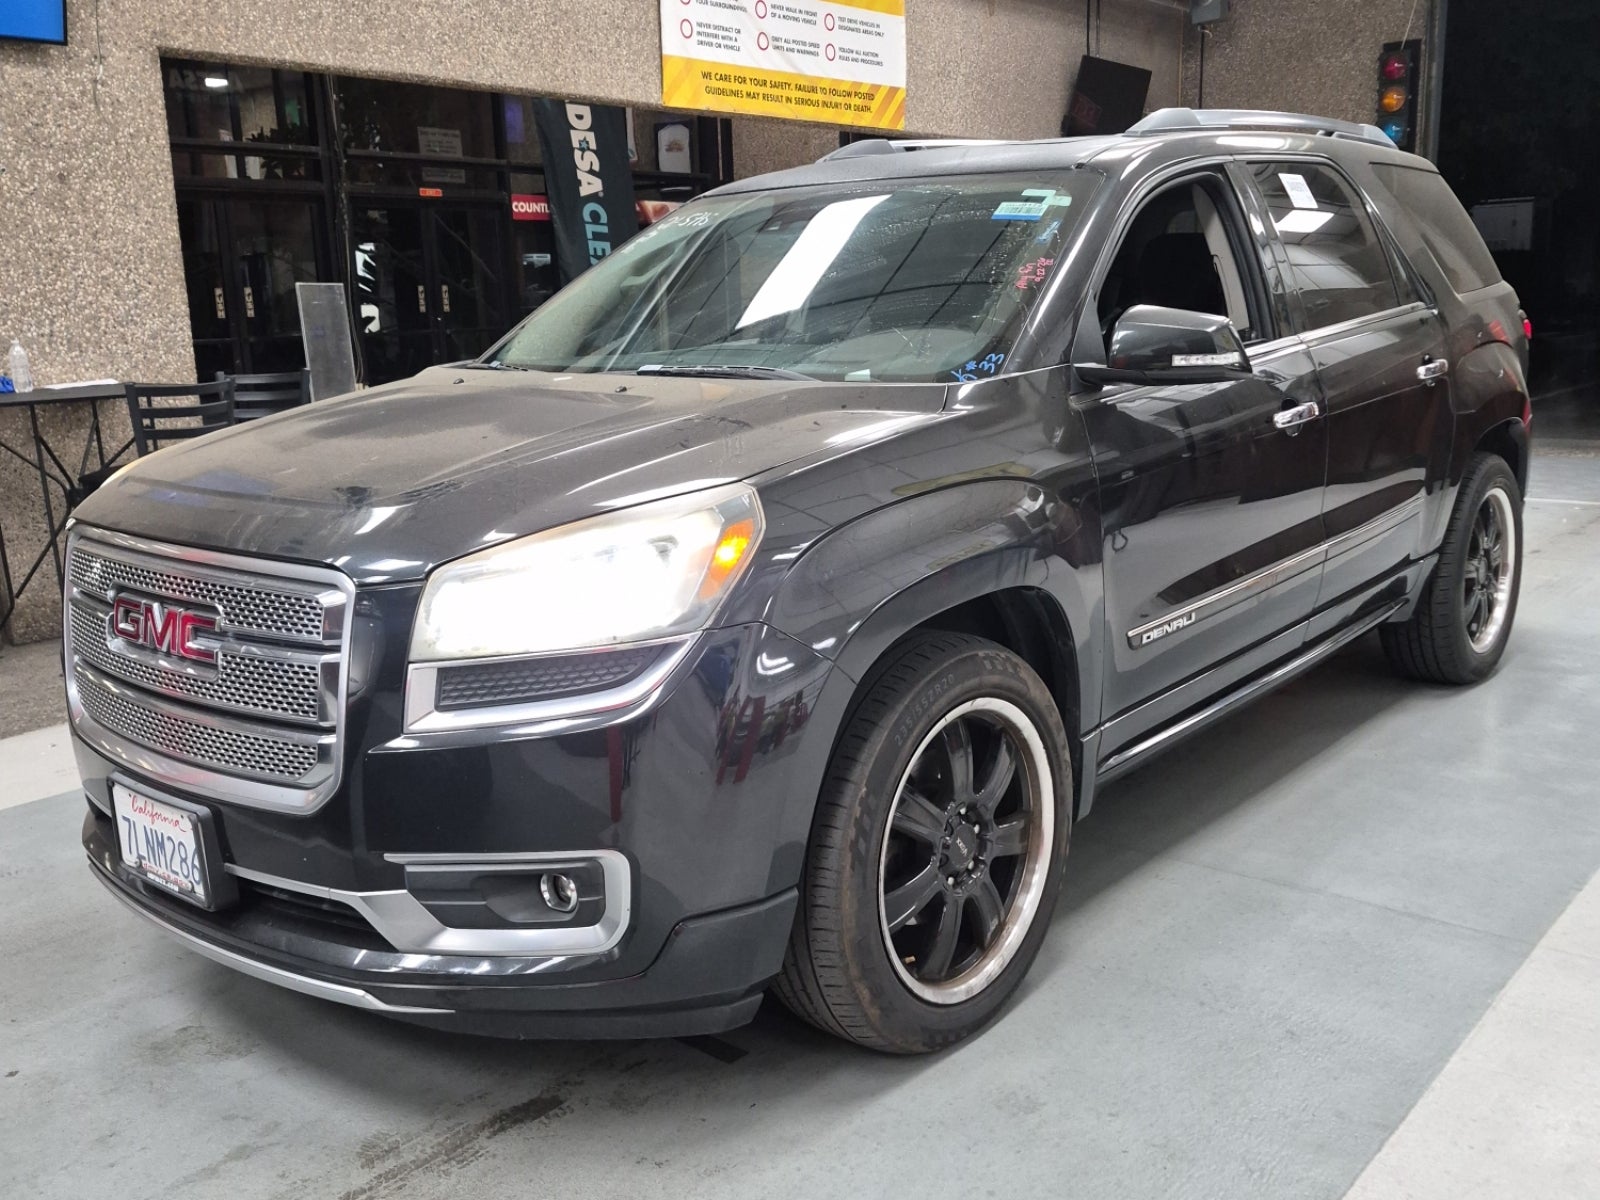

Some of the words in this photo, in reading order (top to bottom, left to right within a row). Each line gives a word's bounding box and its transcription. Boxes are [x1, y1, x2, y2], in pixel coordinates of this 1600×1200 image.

[712, 24, 734, 32] DISTRACT
[782, 14, 800, 23] MOVING
[696, 30, 720, 40] INTERFERE
[697, 40, 714, 48] DRIVER
[723, 44, 740, 52] VEHICLE
[792, 39, 807, 47] POSTED
[796, 48, 820, 57] WARNINGS
[701, 71, 712, 80] WE
[714, 72, 732, 82] CARE
[734, 75, 747, 85] FOR
[749, 78, 768, 88] YOUR
[770, 80, 794, 92] SAFETY.
[795, 83, 818, 94] FAILURE
[820, 87, 828, 96] TO
[829, 88, 852, 98] FOLLOW
[854, 91, 876, 101] POSTED
[705, 85, 744, 98] GUIDELINES
[746, 90, 760, 100] MAY
[762, 93, 784, 104] RESULT
[785, 96, 792, 104] IN
[794, 97, 820, 108] SERIOUS
[821, 100, 842, 110] INJURY
[844, 103, 852, 111] OR
[854, 104, 872, 113] DEATH.
[565, 100, 604, 197] DESA
[113, 594, 221, 664] GMC
[1142, 612, 1196, 645] DENALI
[131, 794, 187, 832] California
[122, 815, 202, 886] 7LNM286
